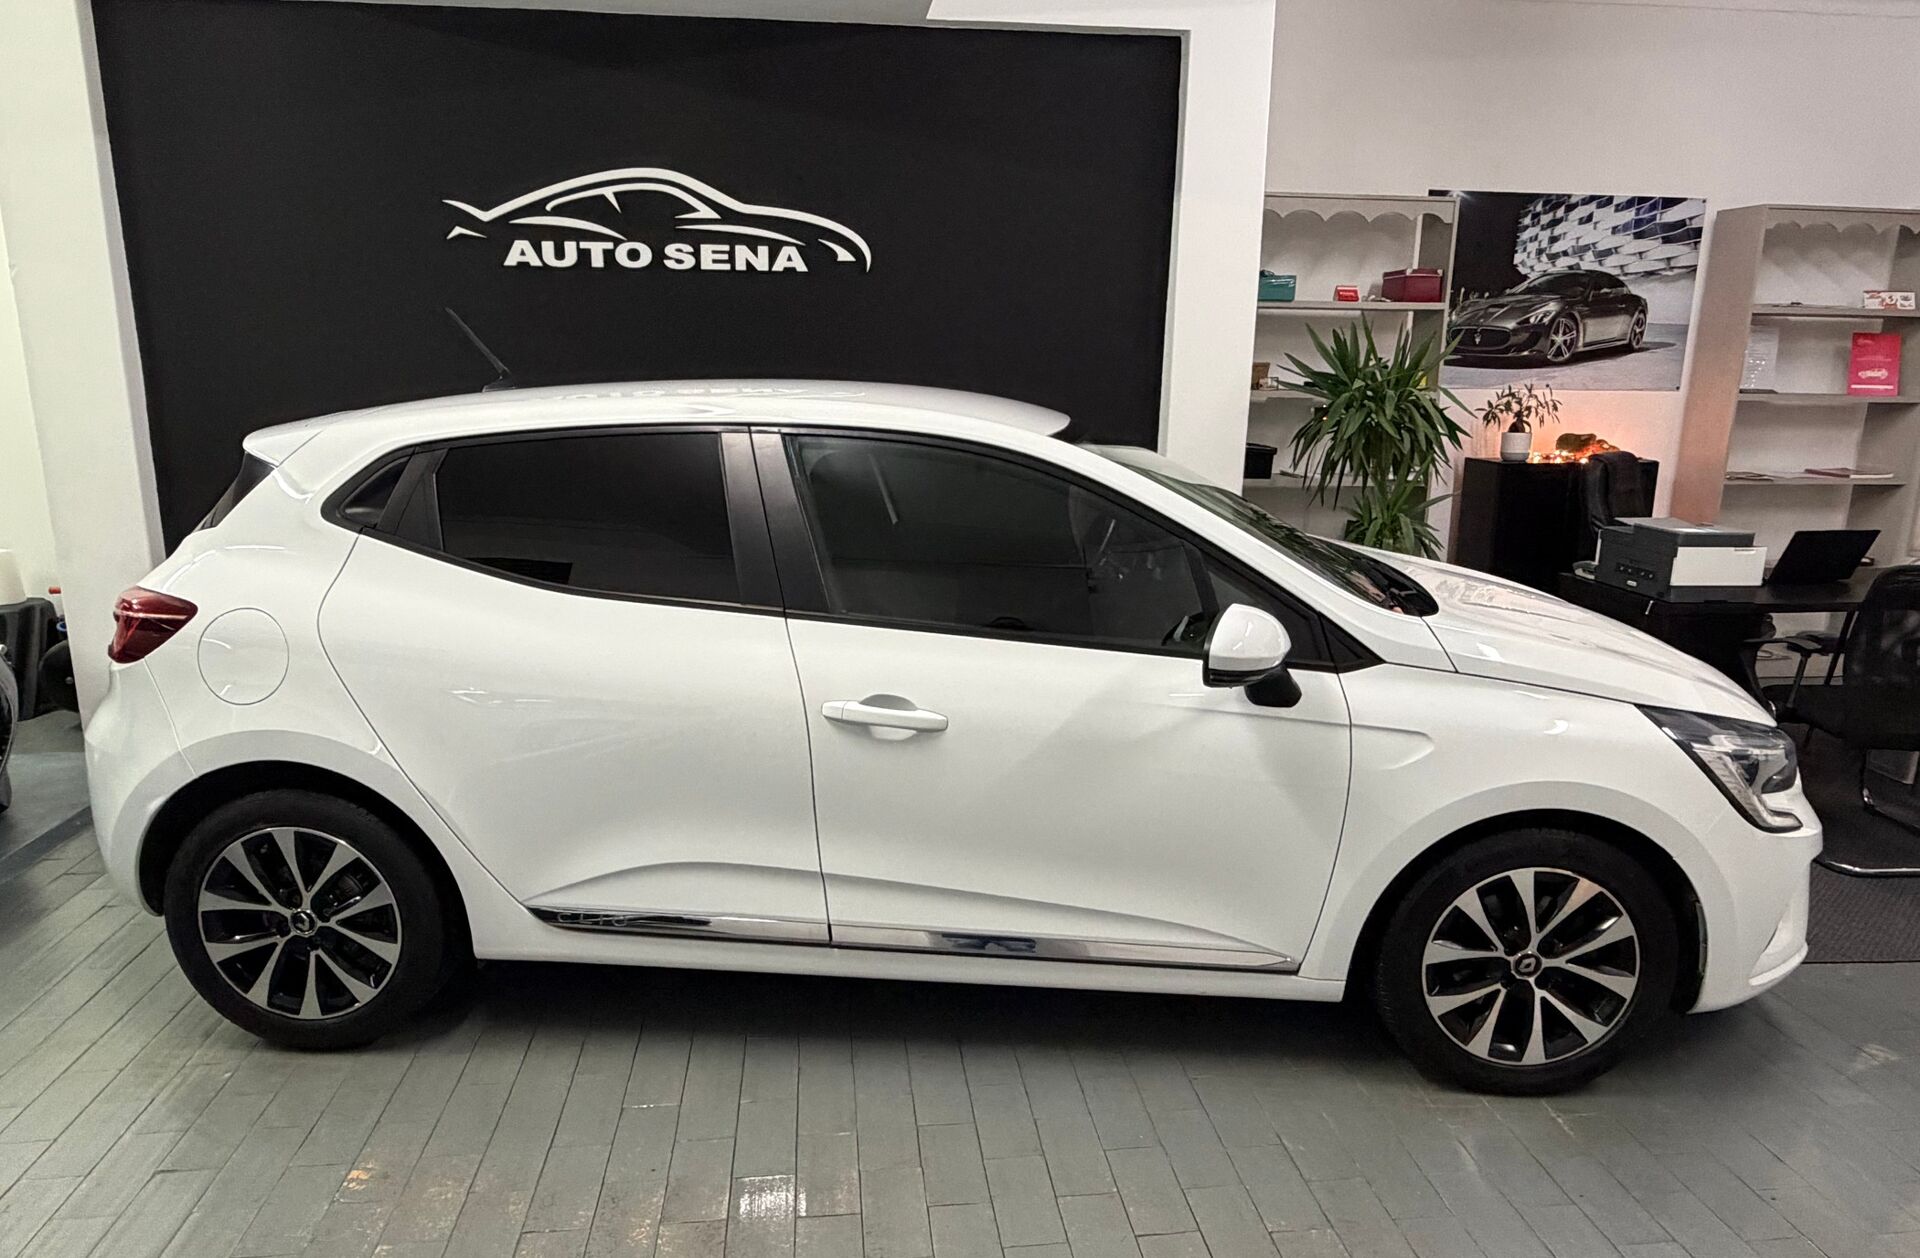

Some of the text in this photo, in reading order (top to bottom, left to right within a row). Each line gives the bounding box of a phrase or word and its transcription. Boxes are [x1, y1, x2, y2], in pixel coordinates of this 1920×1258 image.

[503, 240, 808, 271] AUTO SENA
[558, 912, 627, 926] CLIO
